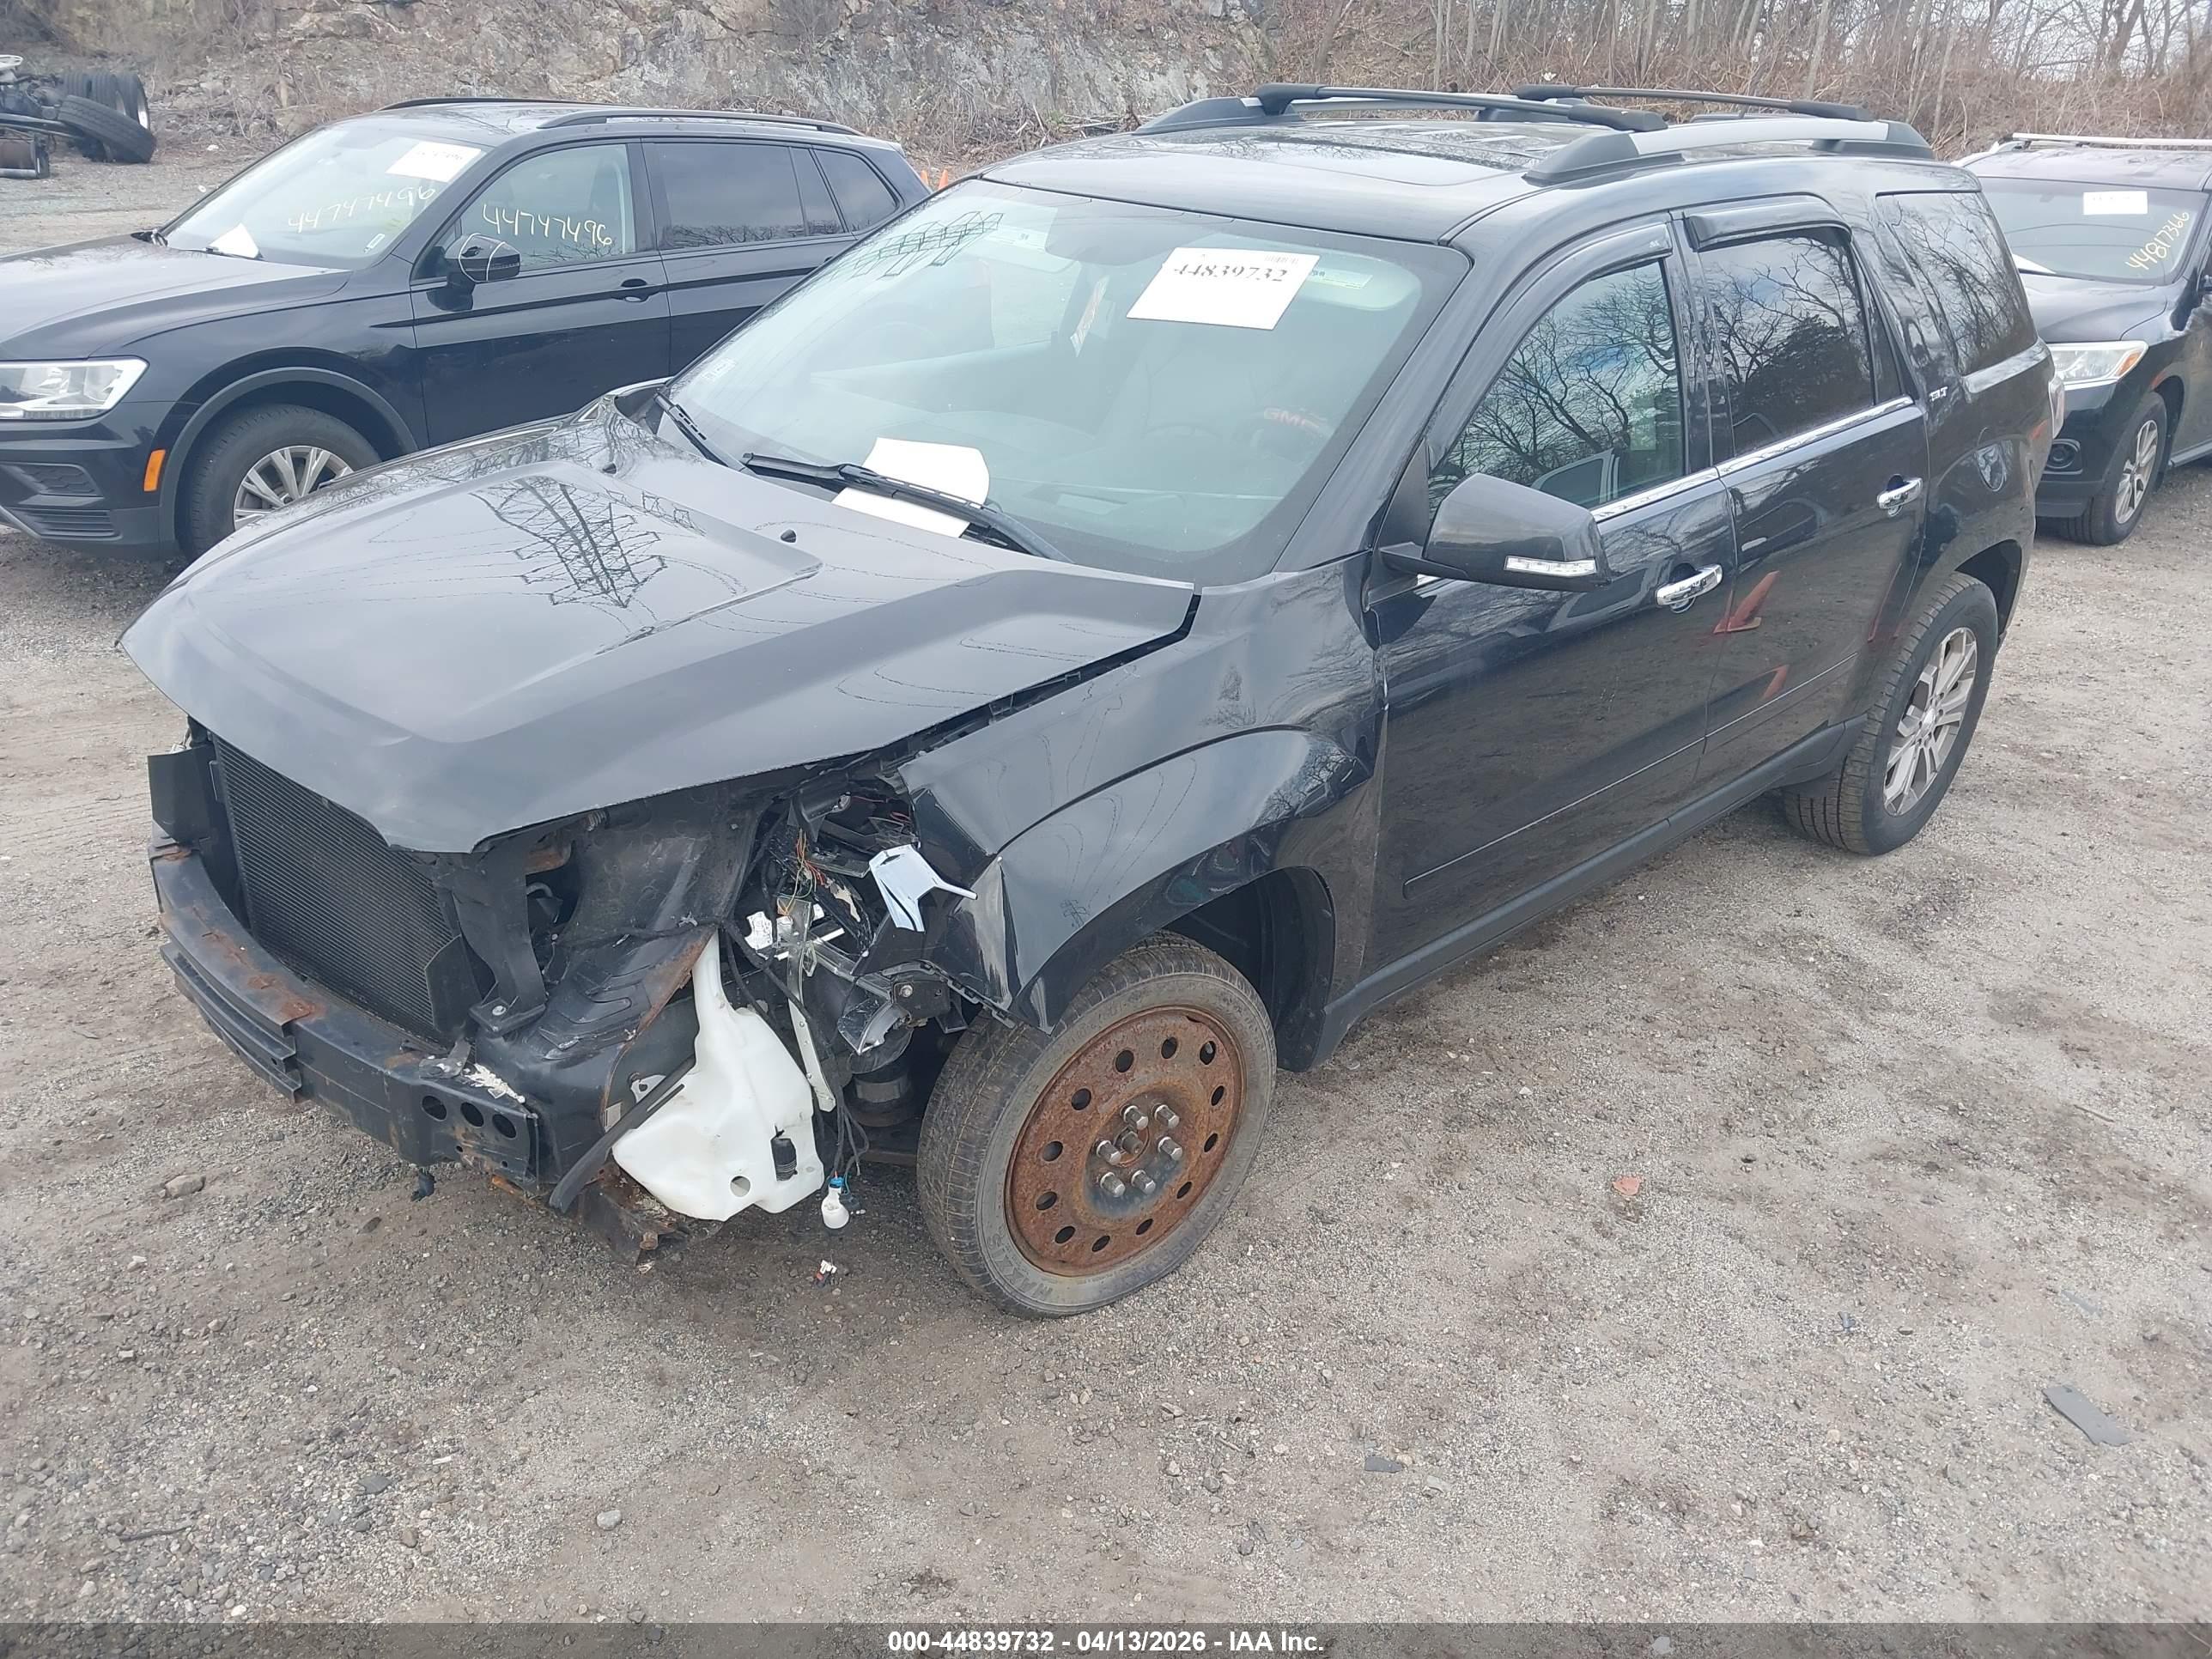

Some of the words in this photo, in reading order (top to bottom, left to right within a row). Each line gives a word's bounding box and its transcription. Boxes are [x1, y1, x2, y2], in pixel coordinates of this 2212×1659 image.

[288, 185, 436, 234] 44747496
[483, 204, 613, 246] 44747496
[2124, 211, 2190, 270] 44817366
[1174, 263, 1288, 282] 44839732
